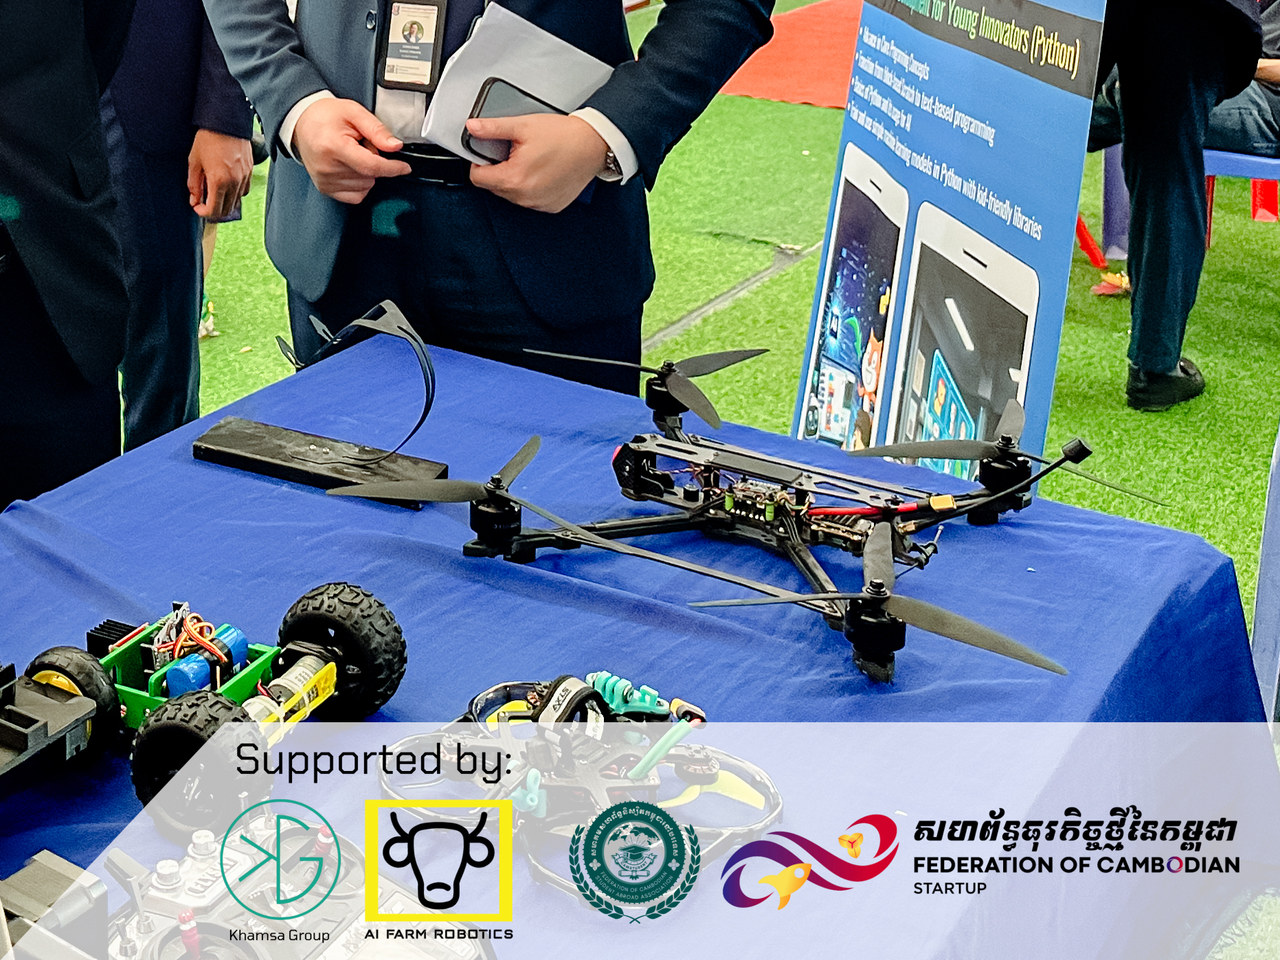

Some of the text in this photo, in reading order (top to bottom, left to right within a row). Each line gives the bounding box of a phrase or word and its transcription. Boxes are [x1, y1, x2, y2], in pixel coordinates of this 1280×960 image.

[979, 7, 1030, 54] Innovators
[1030, 25, 1081, 80] (Python)
[921, 92, 955, 123] text-based
[953, 110, 995, 147] programming
[911, 152, 933, 177] models
[932, 159, 940, 180] in
[940, 163, 962, 187] Python
[962, 178, 977, 200] with
[976, 184, 1013, 225] kid-friendly
[1012, 205, 1042, 240] libraries
